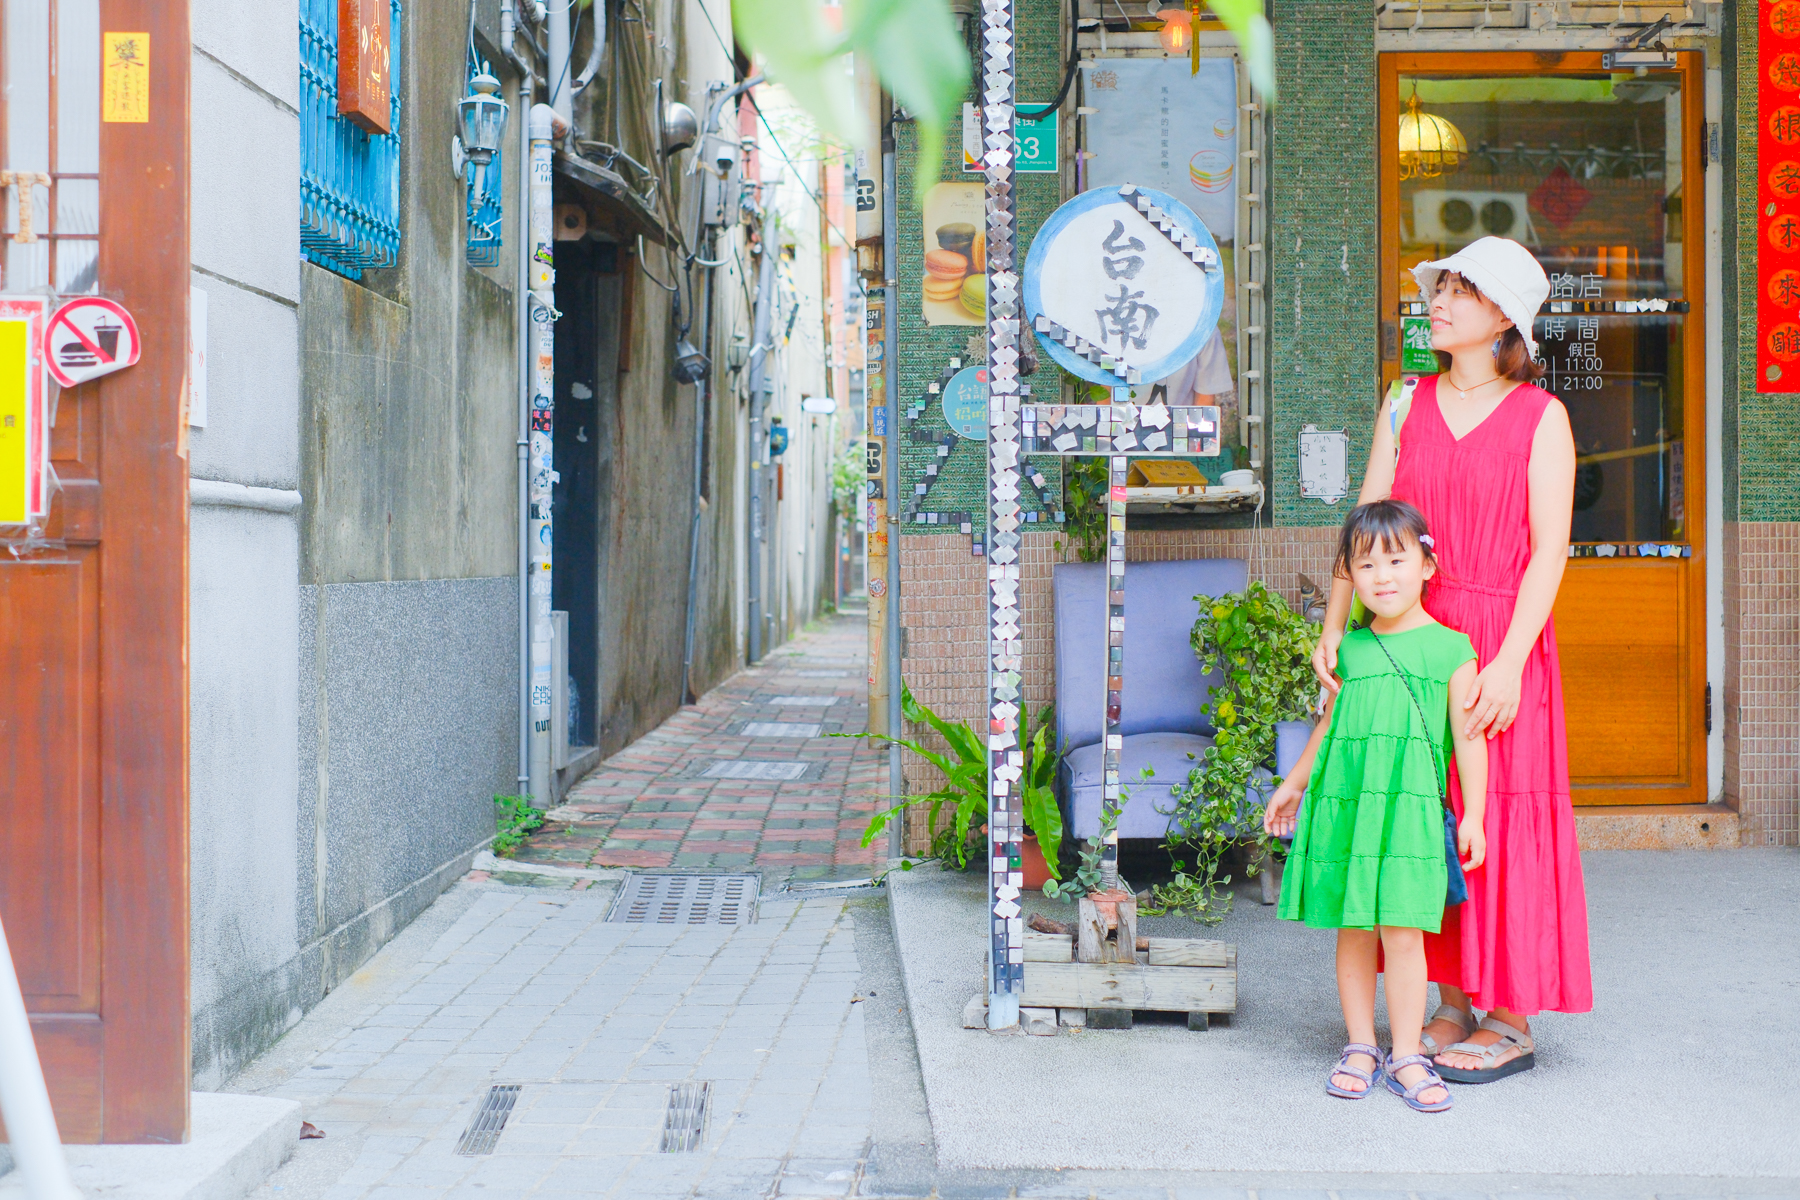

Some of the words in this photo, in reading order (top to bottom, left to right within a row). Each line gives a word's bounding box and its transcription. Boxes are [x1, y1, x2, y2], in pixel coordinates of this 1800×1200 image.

[1095, 219, 1160, 354] 台南
[1550, 272, 1604, 298] 路店
[1544, 319, 1599, 341] 時間
[1568, 342, 1596, 358] 假日
[1565, 357, 1603, 371] 11:00
[1564, 376, 1603, 391] 21:00
